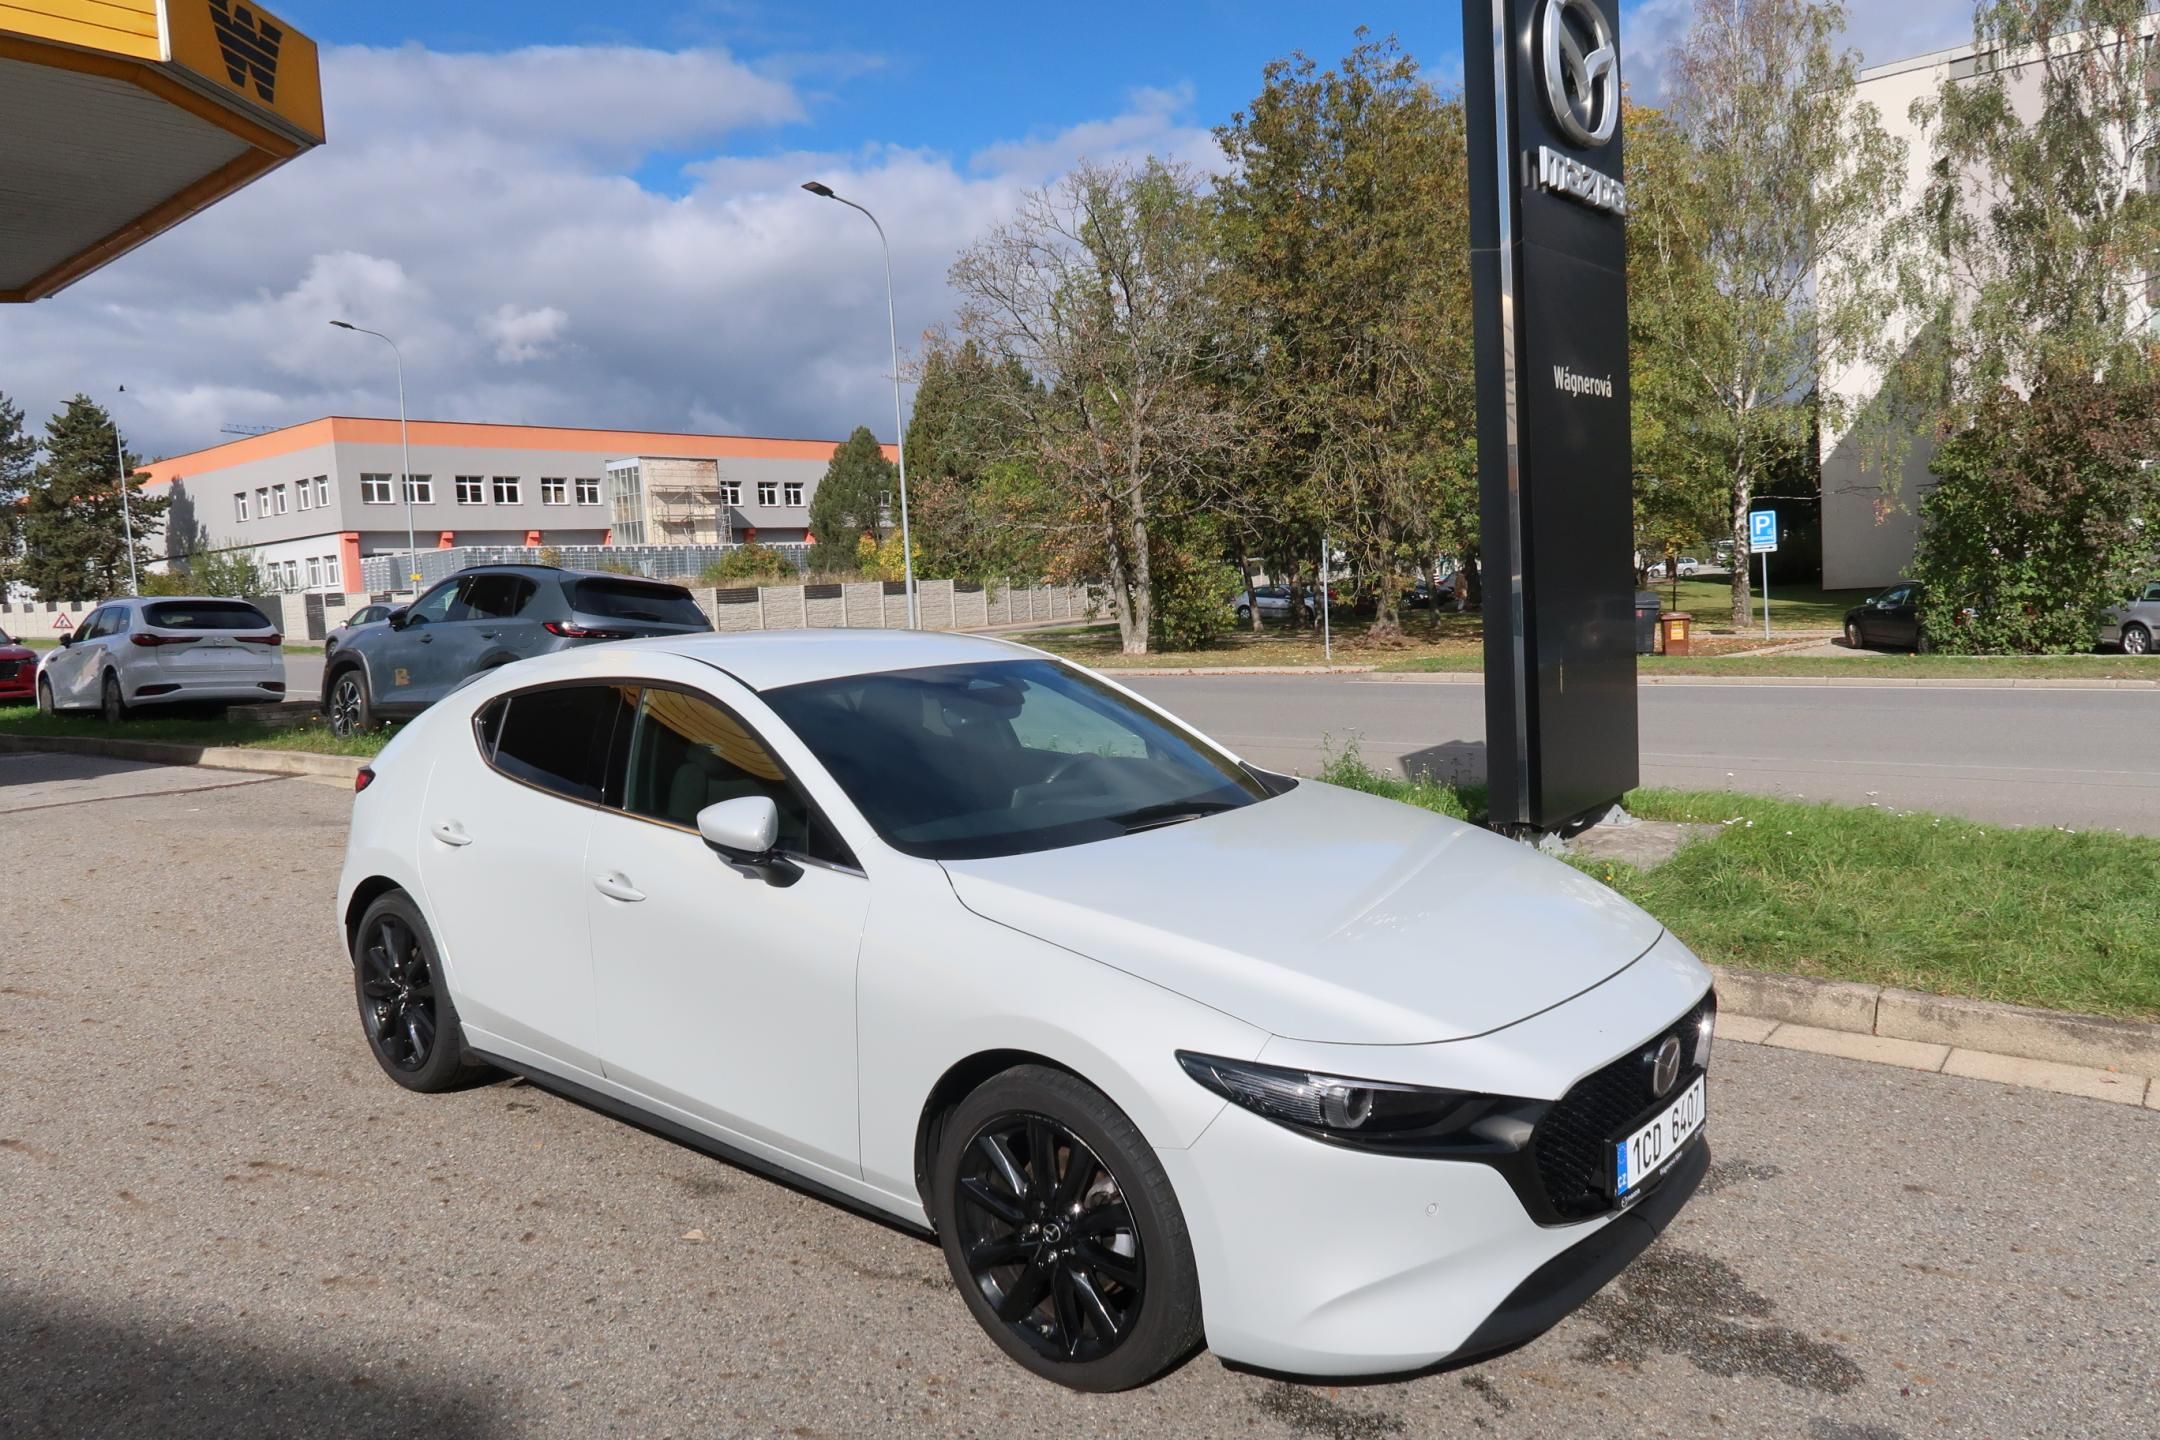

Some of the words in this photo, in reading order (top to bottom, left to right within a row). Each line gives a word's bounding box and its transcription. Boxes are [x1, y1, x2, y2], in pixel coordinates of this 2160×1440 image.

[1539, 145, 1627, 215] mazda
[1553, 364, 1612, 398] Wágnerová
[1755, 515, 1770, 535] P
[1634, 1123, 1661, 1174] 1CD
[1672, 1086, 1699, 1143] 6407
[1617, 1172, 1627, 1187] CZ
